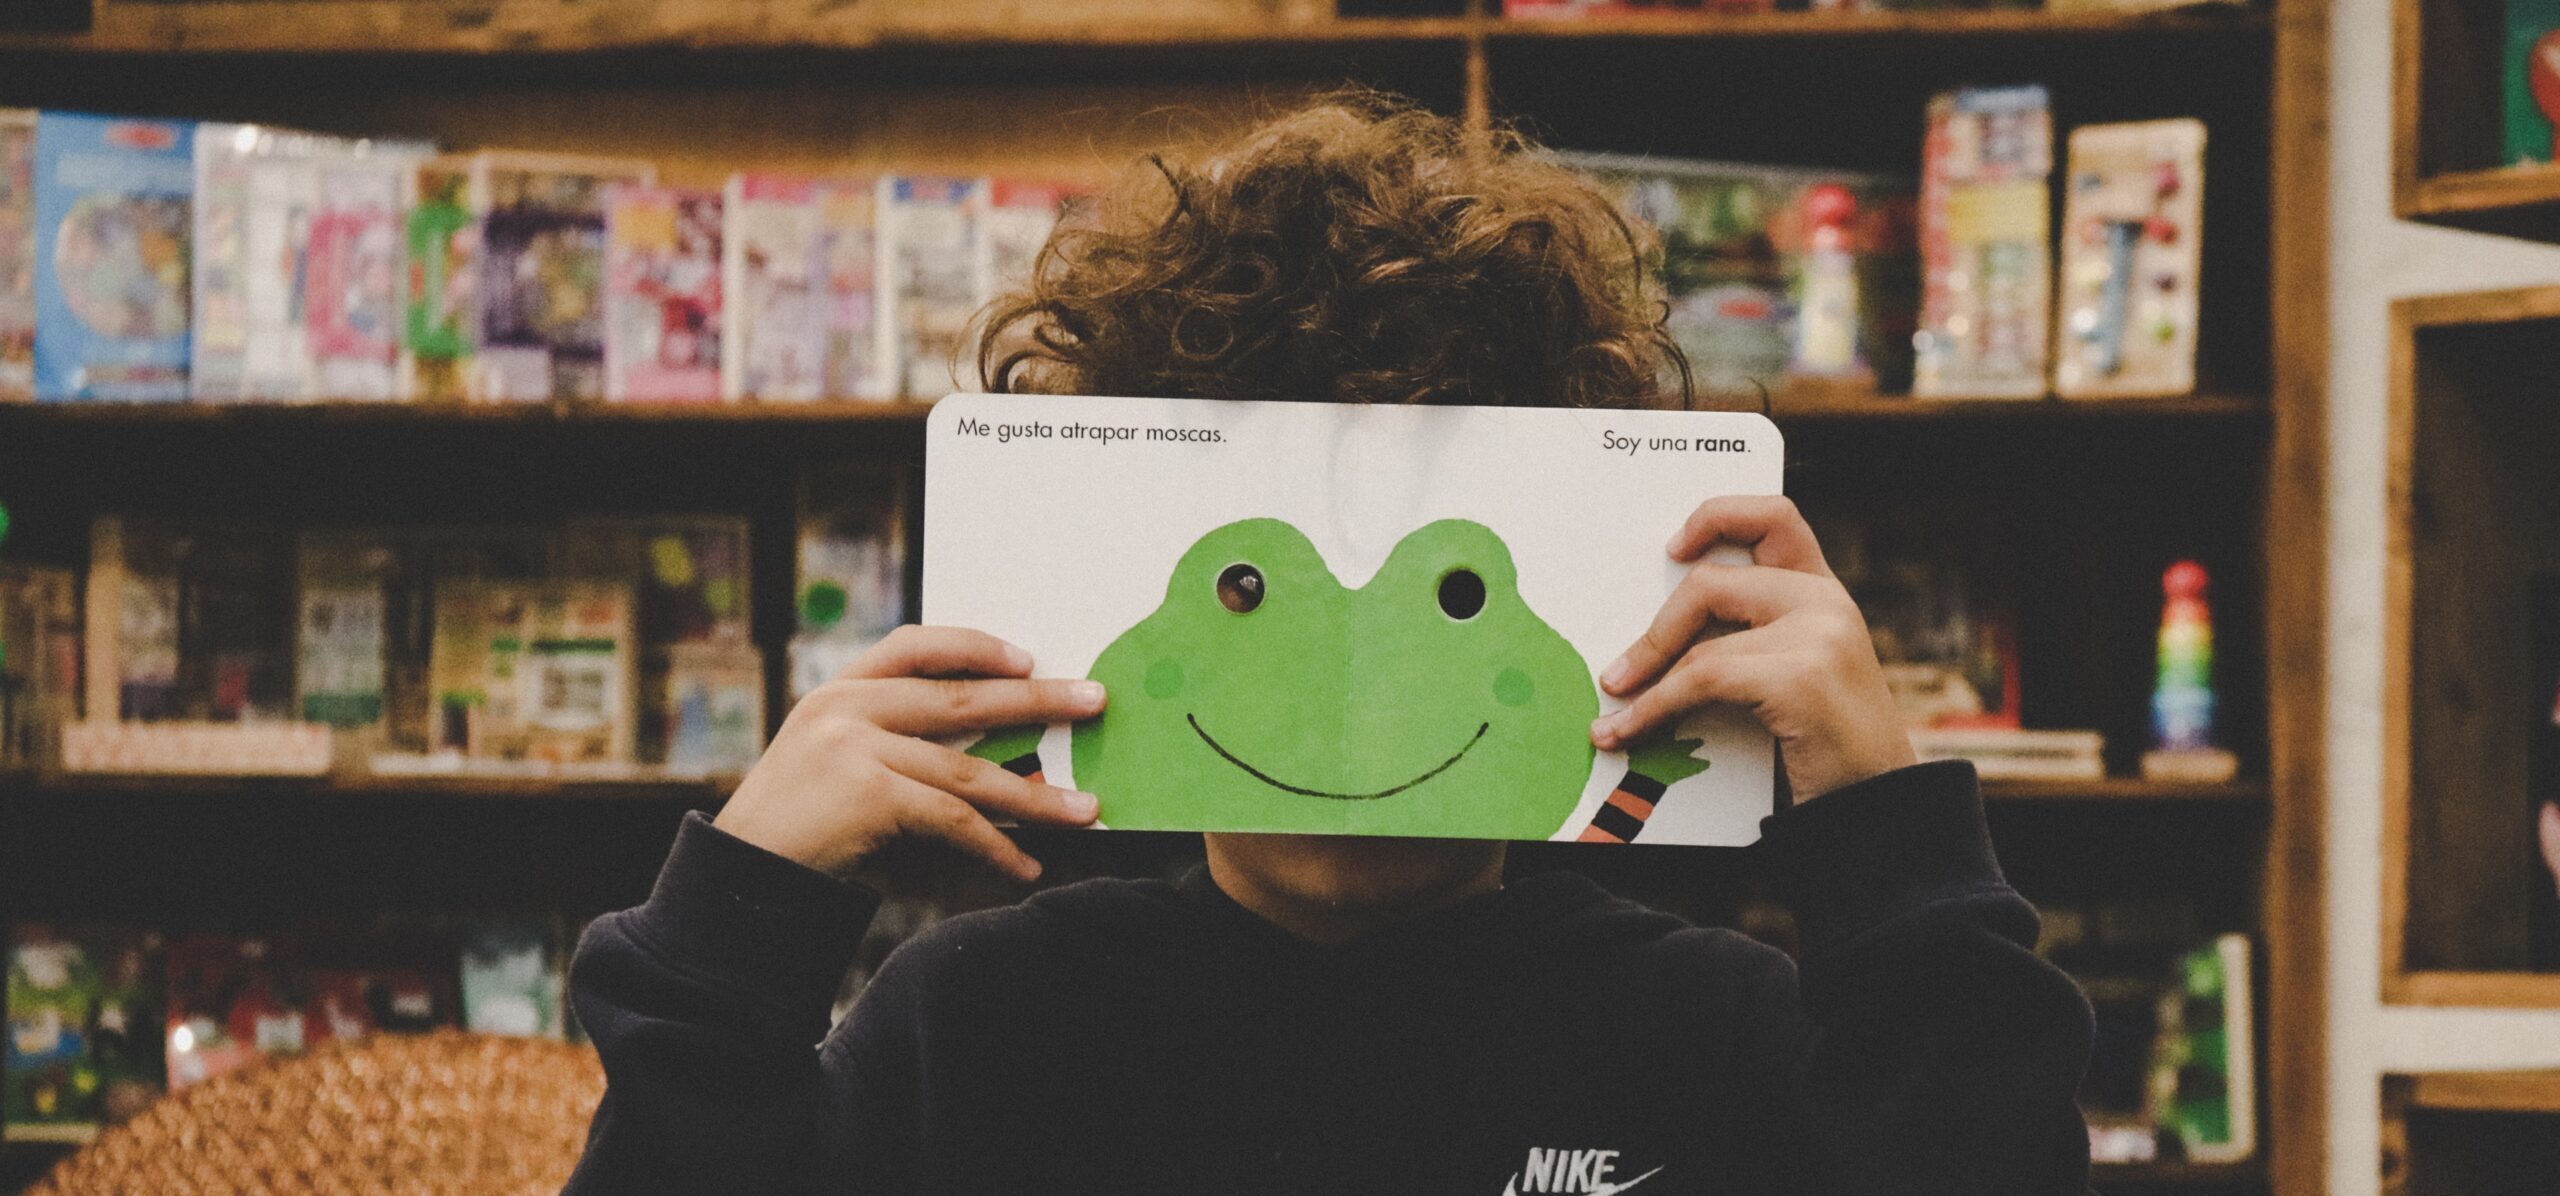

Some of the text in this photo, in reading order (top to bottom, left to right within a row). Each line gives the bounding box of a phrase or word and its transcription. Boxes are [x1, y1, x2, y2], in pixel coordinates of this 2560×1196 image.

[957, 417, 1228, 446] Me gusta atrapar moscas.
[1603, 429, 1751, 456] Soy una rana.
[1522, 1146, 1620, 1193] NIKE
